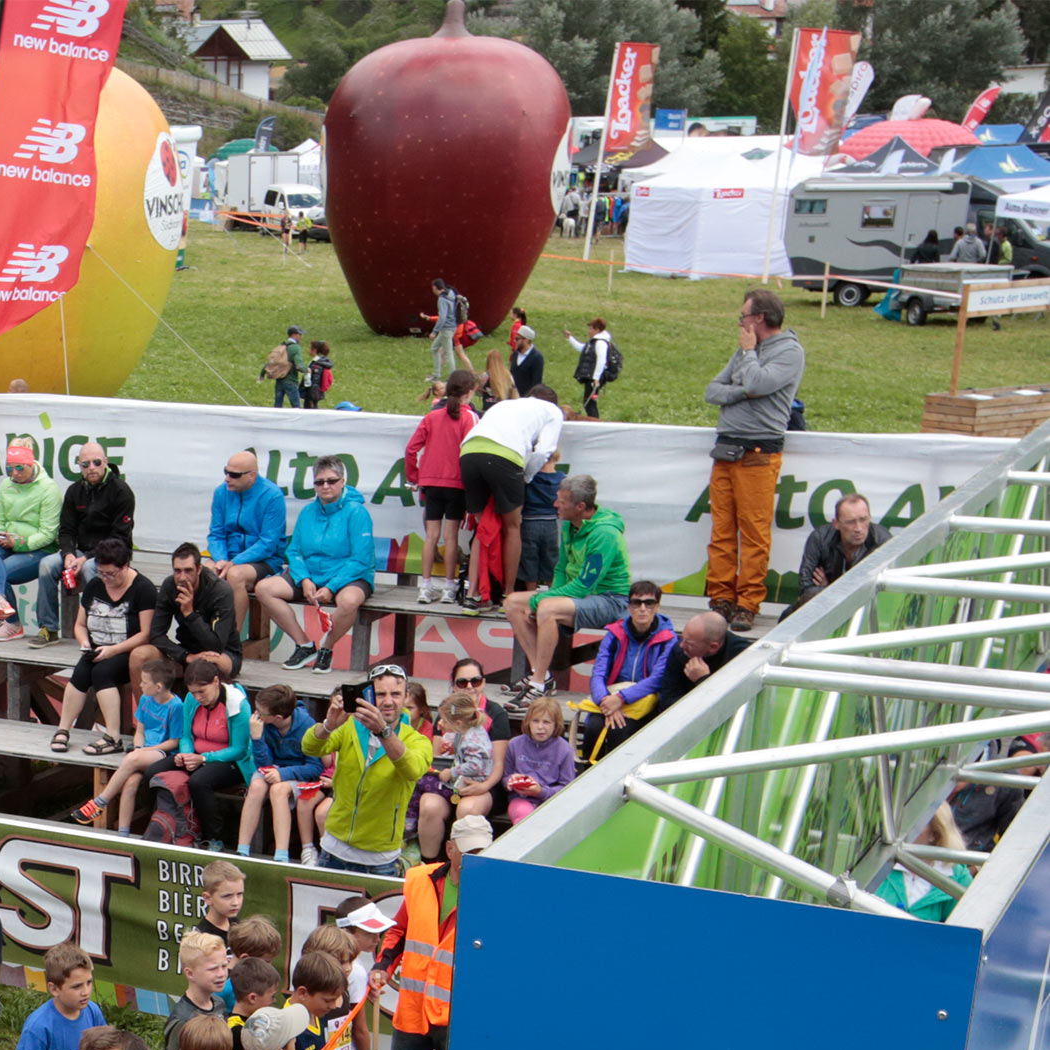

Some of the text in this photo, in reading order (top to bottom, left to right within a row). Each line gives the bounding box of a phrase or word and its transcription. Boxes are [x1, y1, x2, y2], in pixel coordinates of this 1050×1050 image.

[14, 33, 109, 62] new balance
[610, 46, 637, 139] Loacker
[32, 165, 91, 187] balance
[244, 447, 359, 500] LTO
[157, 858, 205, 887] BIRR
[157, 884, 209, 918] BIÈR
[156, 919, 200, 945] BE
